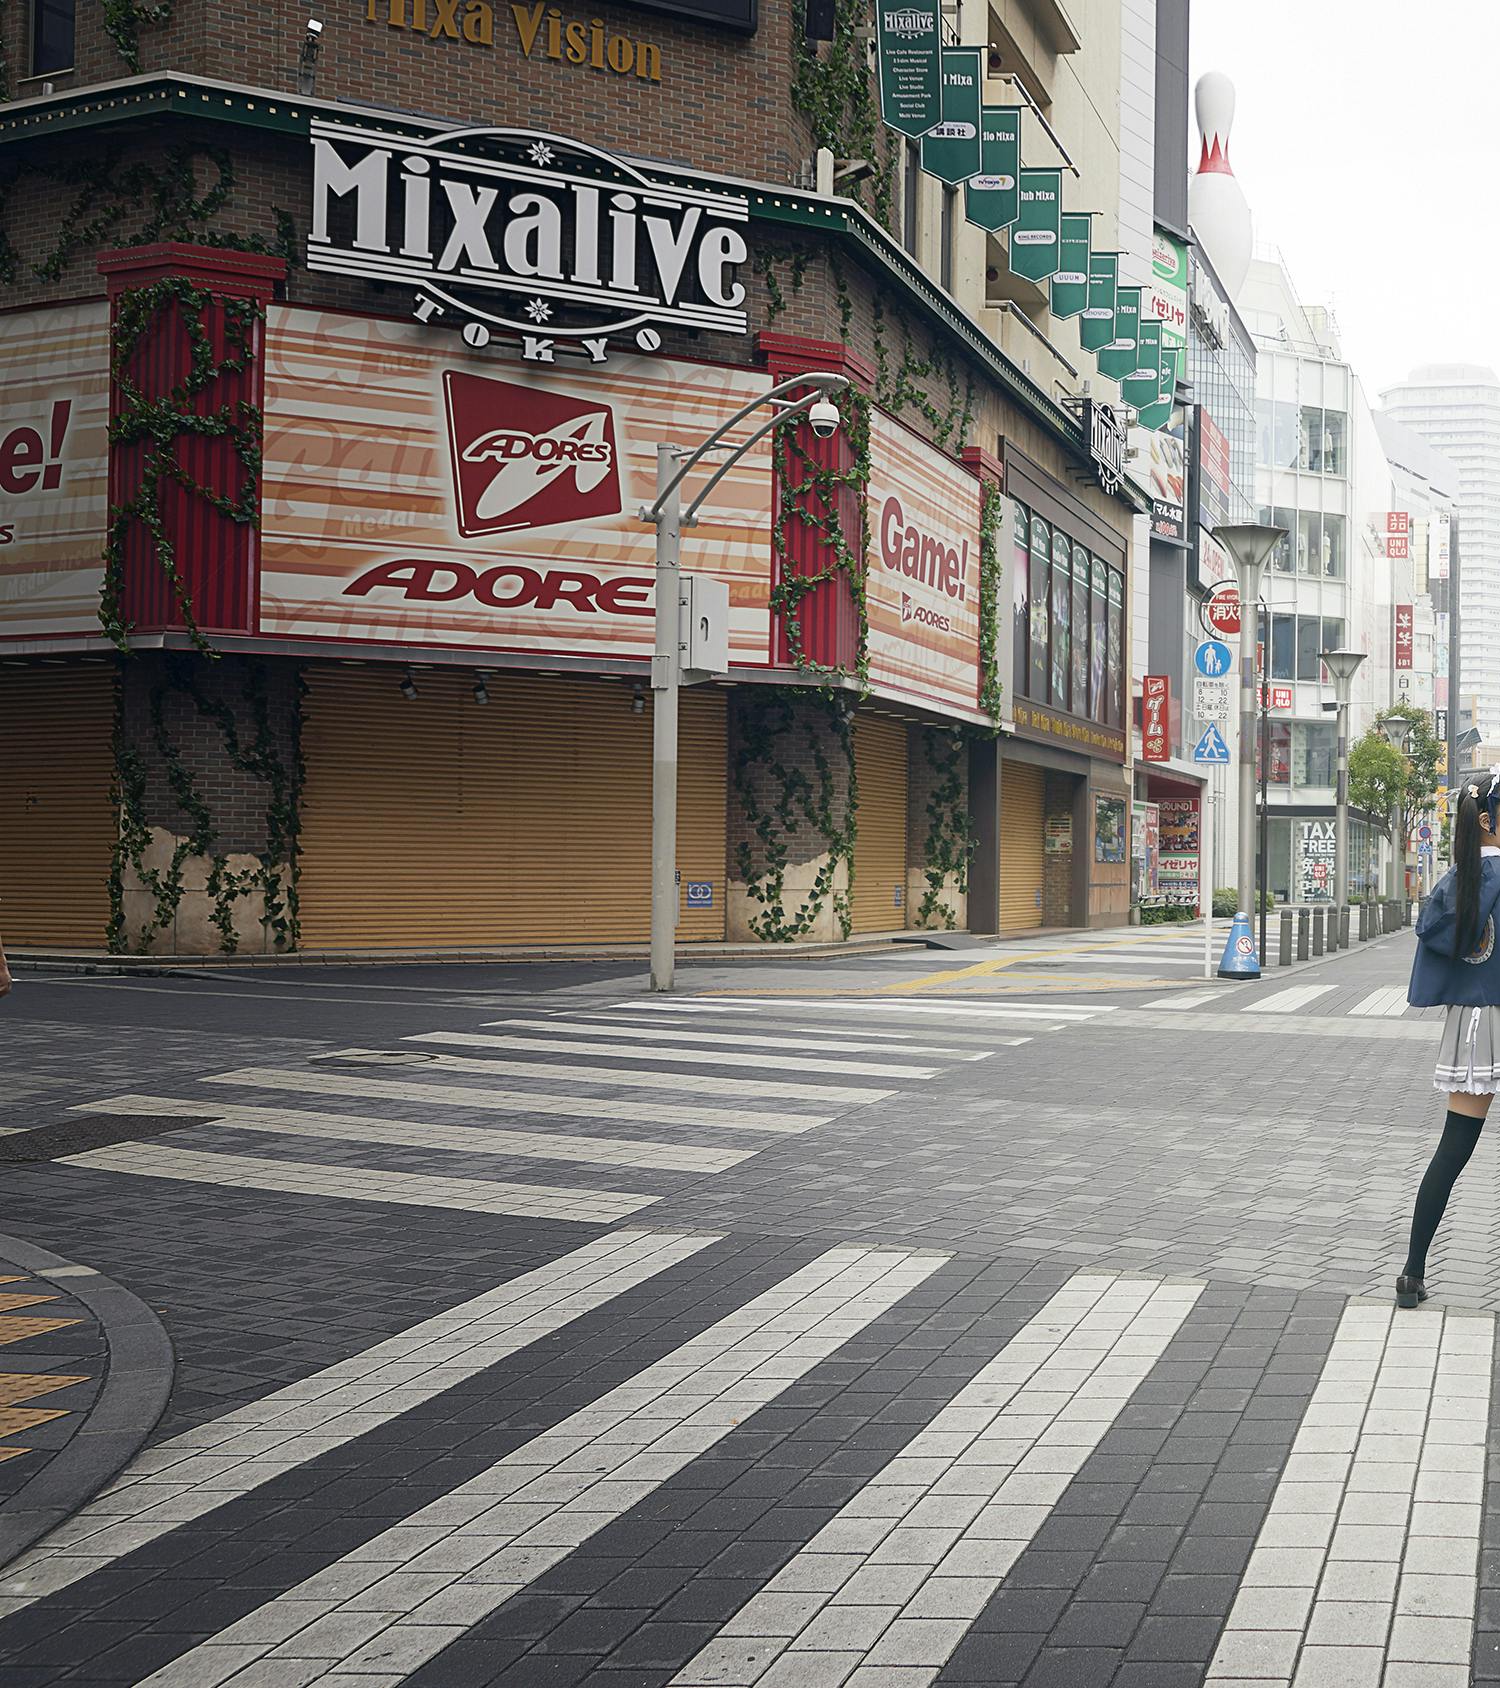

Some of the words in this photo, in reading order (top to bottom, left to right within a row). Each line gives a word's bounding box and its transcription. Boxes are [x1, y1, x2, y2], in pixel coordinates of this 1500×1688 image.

[513, 0, 663, 82] Vision
[949, 74, 973, 86] Mixa
[996, 132, 1015, 142] Mixa
[1036, 191, 1055, 201] Mixa
[310, 136, 748, 306] Mixalive
[412, 293, 662, 364] TOKYO
[464, 432, 610, 463] ADORES
[880, 496, 969, 602] Game!
[1389, 538, 1407, 547] UNI
[341, 558, 657, 615] ADORE
[912, 605, 951, 632] ADORES
[1147, 695, 1165, 732] ゲーム
[1300, 822, 1336, 839] TAX
[1300, 839, 1337, 853] FREE
[1159, 860, 1197, 870] イゼリヤ
